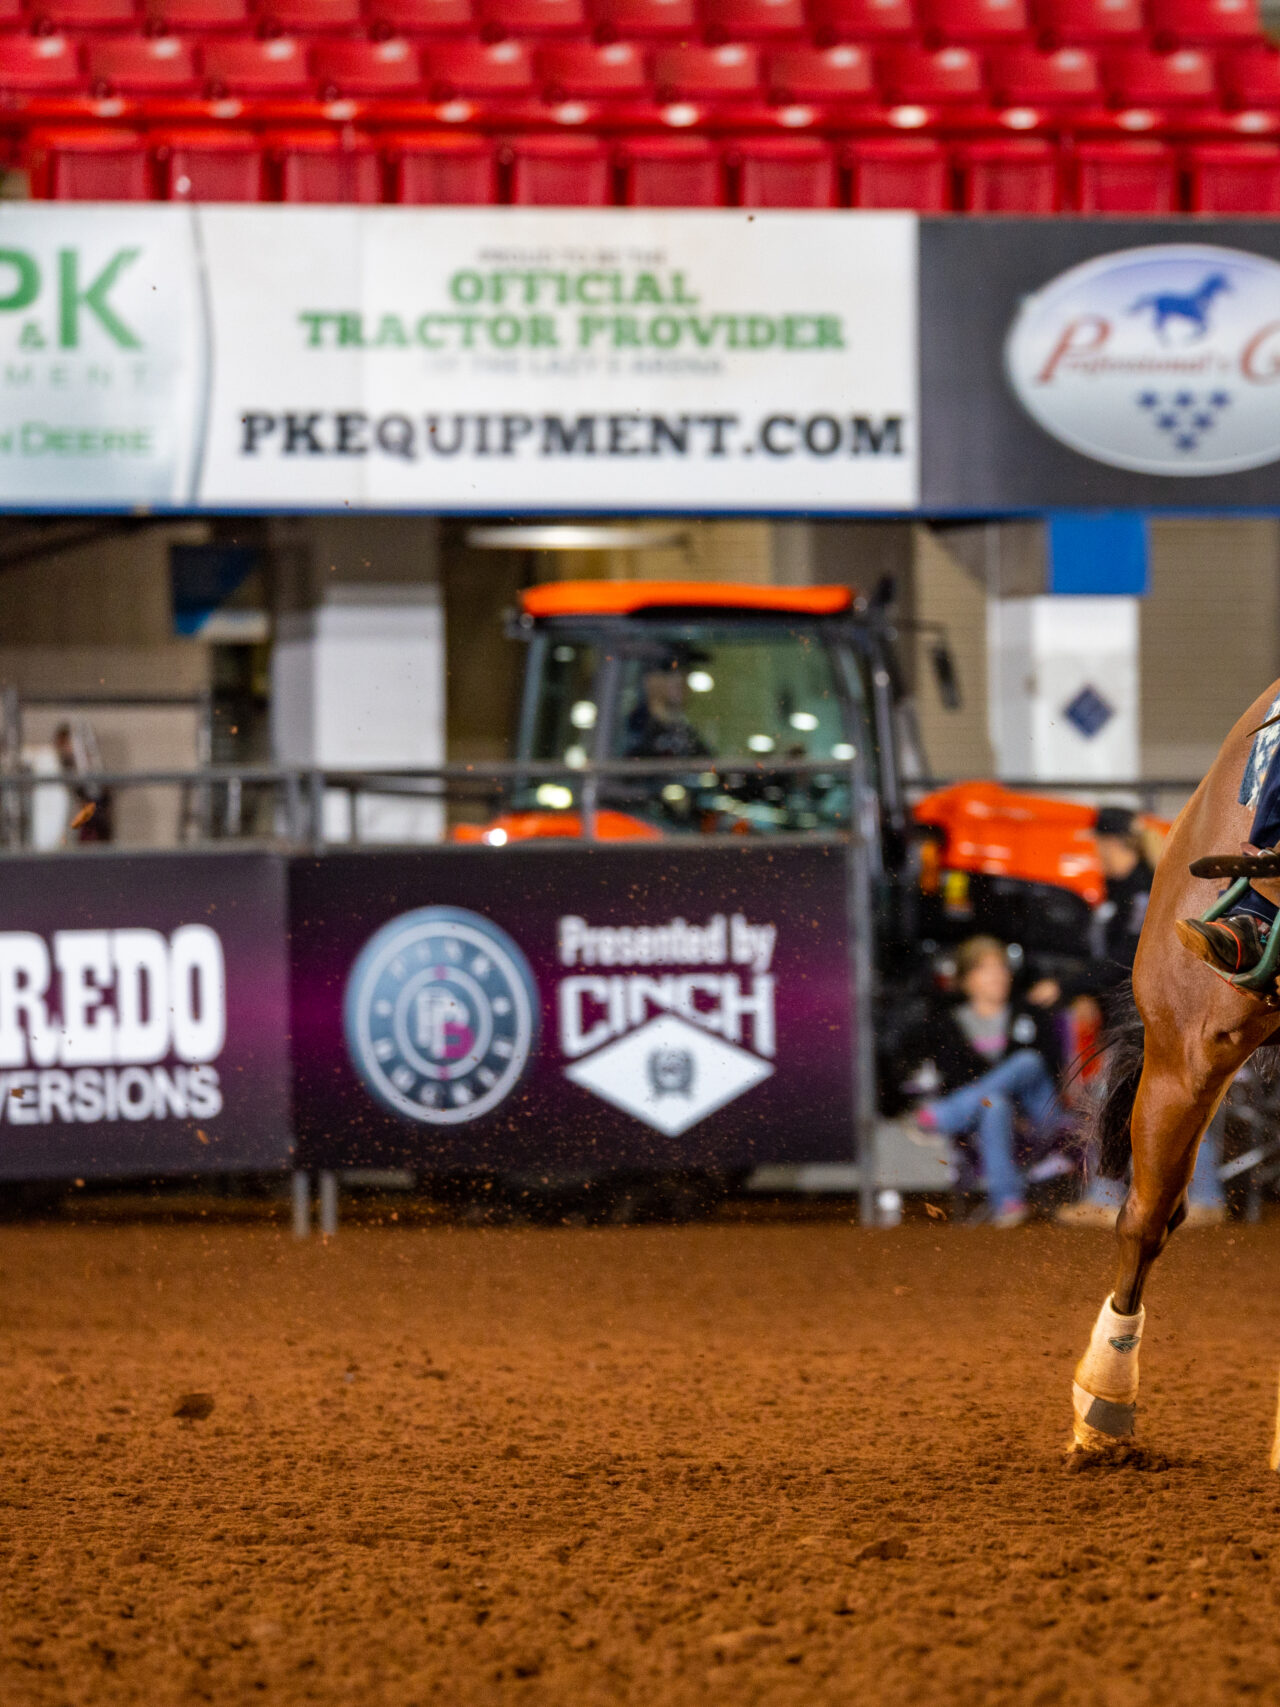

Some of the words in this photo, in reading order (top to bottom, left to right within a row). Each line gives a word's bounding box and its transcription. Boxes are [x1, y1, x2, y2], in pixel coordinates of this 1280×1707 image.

[449, 269, 700, 307] OFFICIAL
[300, 311, 558, 350] TRACTOR
[577, 313, 848, 351] PROVIDER
[240, 411, 906, 461] PKEQUIPMENT.COM
[558, 913, 727, 966] Presented
[729, 913, 777, 974] by
[559, 973, 778, 1060] CINCH
